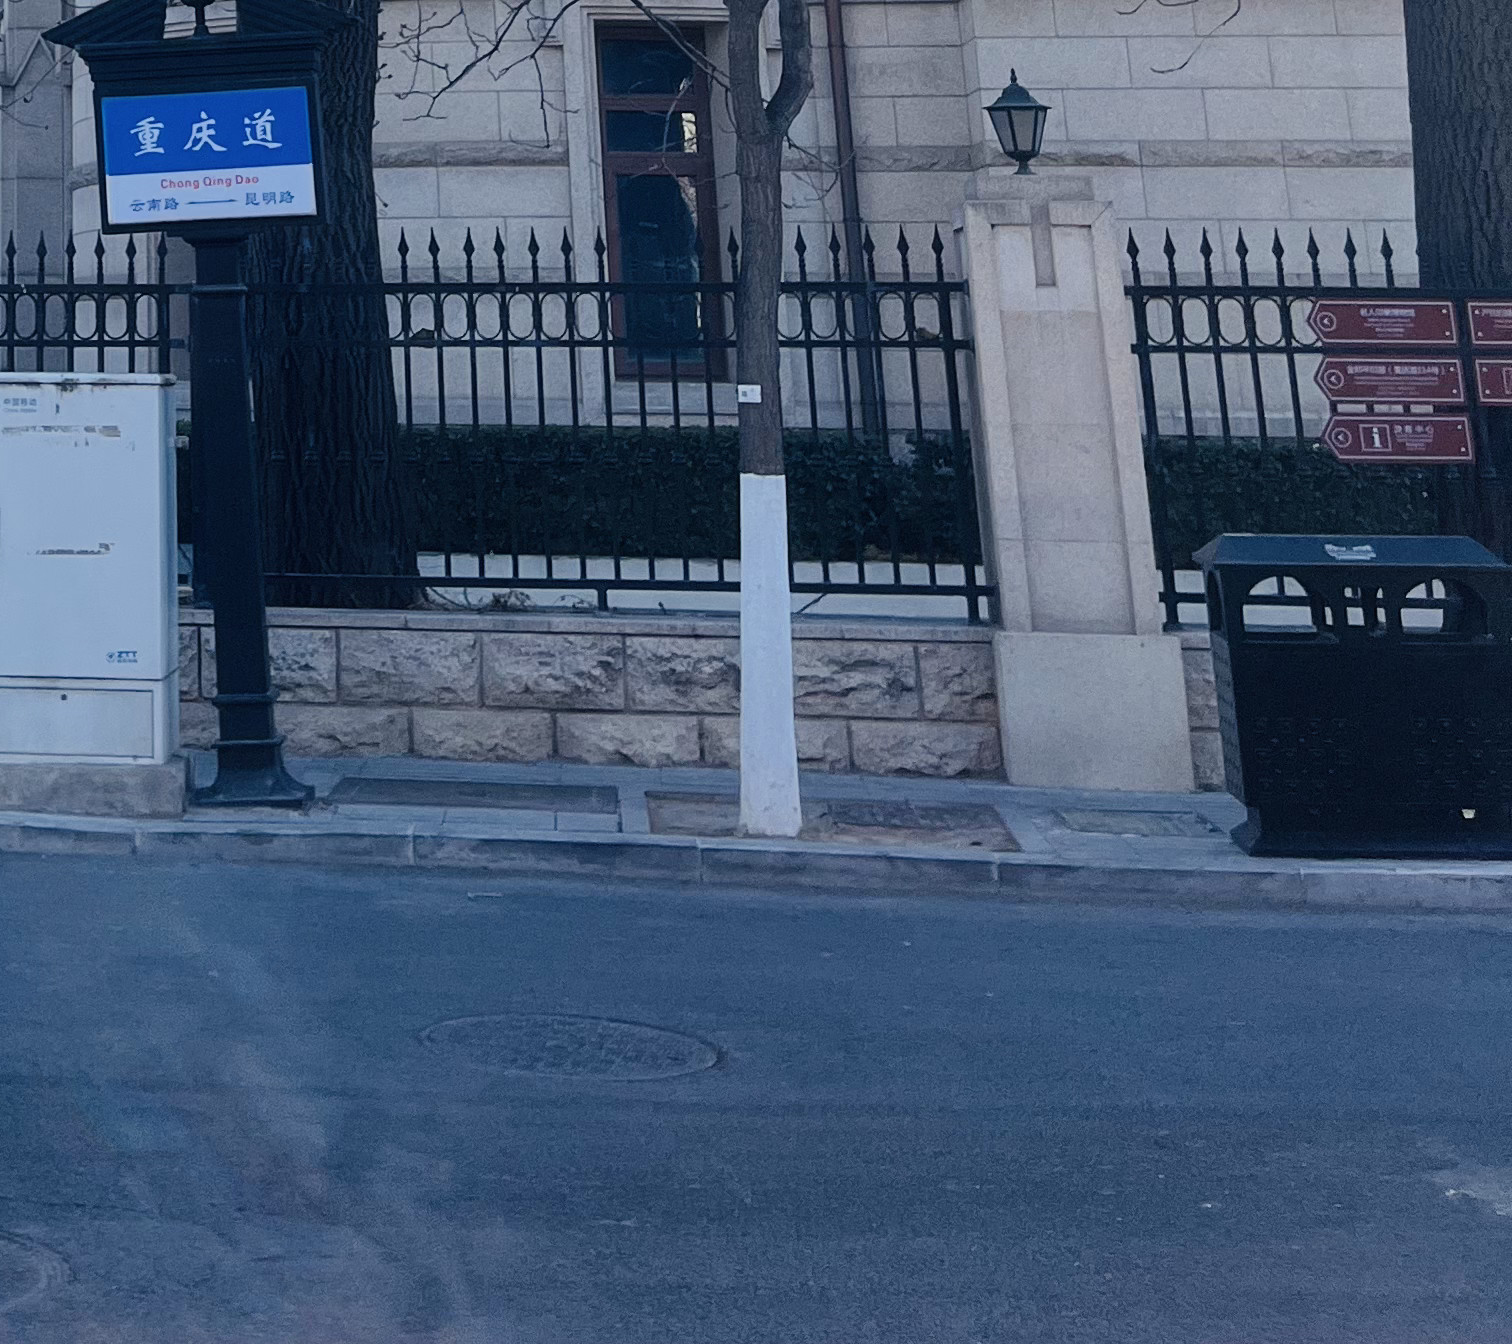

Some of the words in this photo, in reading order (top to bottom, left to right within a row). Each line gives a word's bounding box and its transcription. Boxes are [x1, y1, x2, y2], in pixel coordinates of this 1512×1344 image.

[130, 108, 283, 157] 重庆道
[160, 178, 200, 190] Chong
[203, 176, 232, 188] Qing
[235, 174, 260, 185] Dao
[130, 196, 180, 212] 云南路
[245, 189, 295, 206] 昆明路
